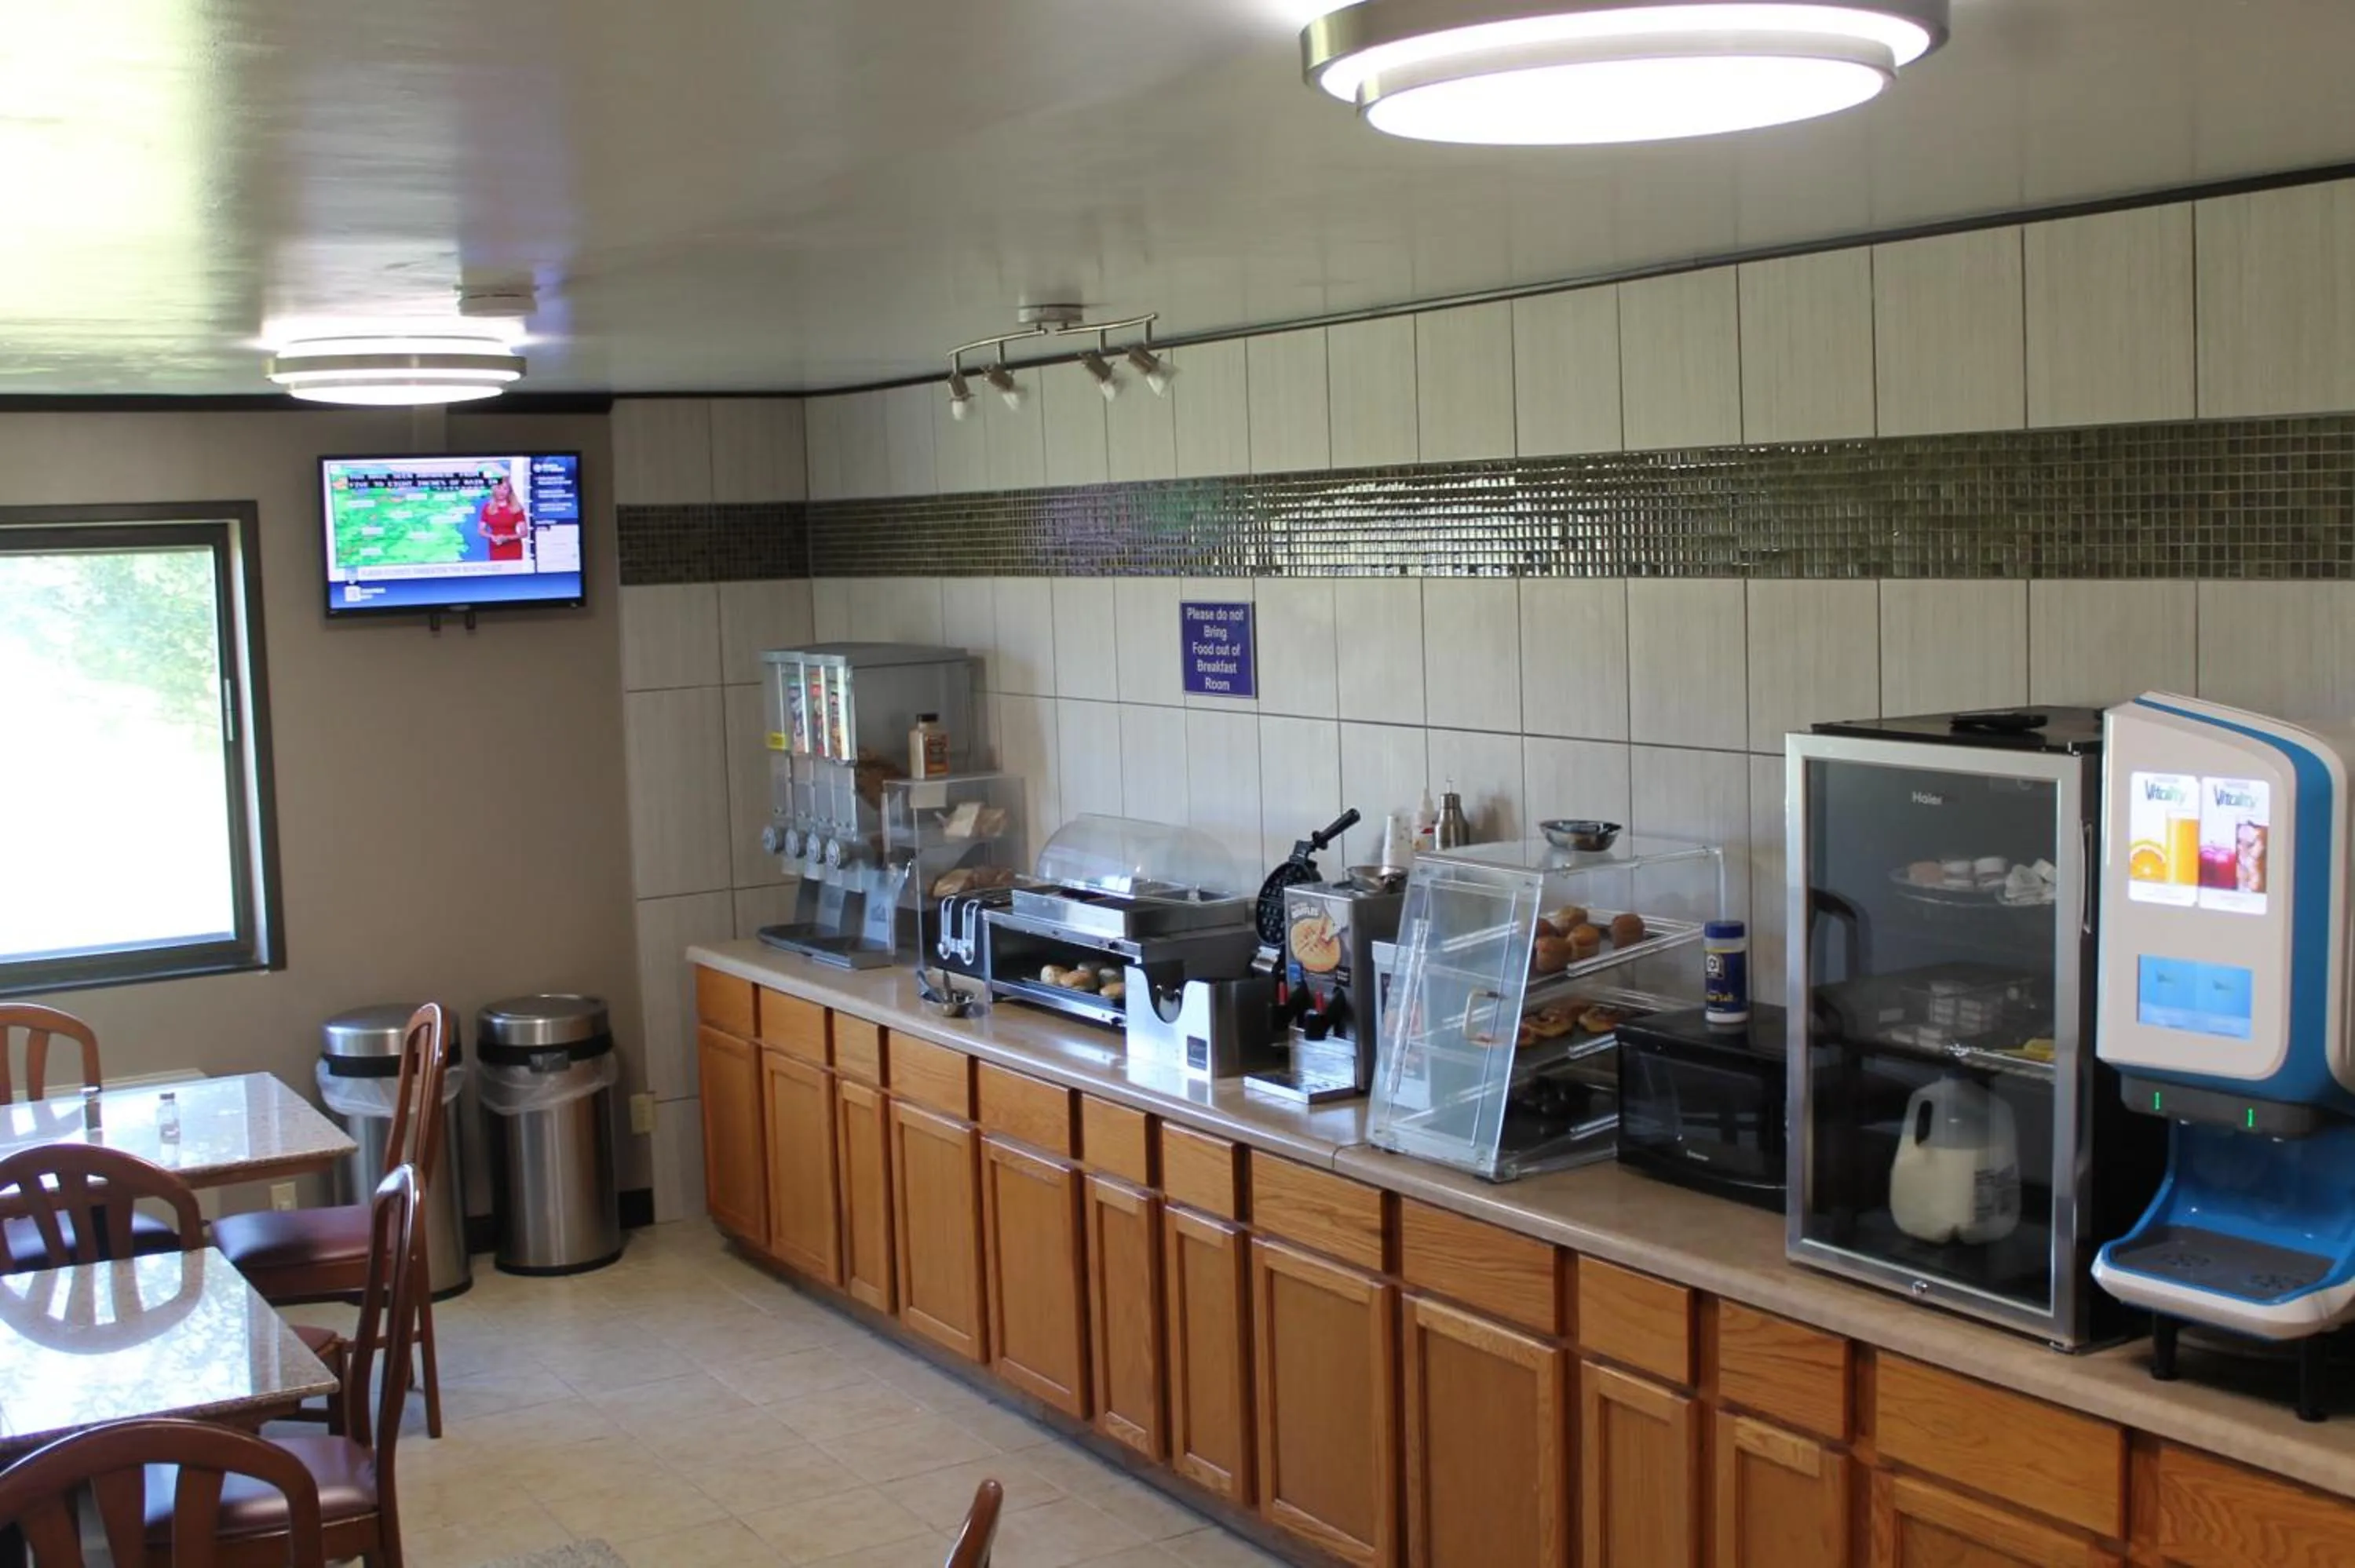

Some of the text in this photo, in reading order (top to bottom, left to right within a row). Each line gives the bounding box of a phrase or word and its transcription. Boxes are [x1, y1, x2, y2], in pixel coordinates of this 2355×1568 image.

[1186, 607, 1244, 622] Please do not
[1203, 625, 1227, 641] Bring
[1192, 641, 1241, 656] Food out of
[1196, 659, 1237, 674] Breakfast
[1205, 676, 1230, 691] Room
[2145, 779, 2187, 805] Vitality
[2213, 784, 2258, 808] Vitality
